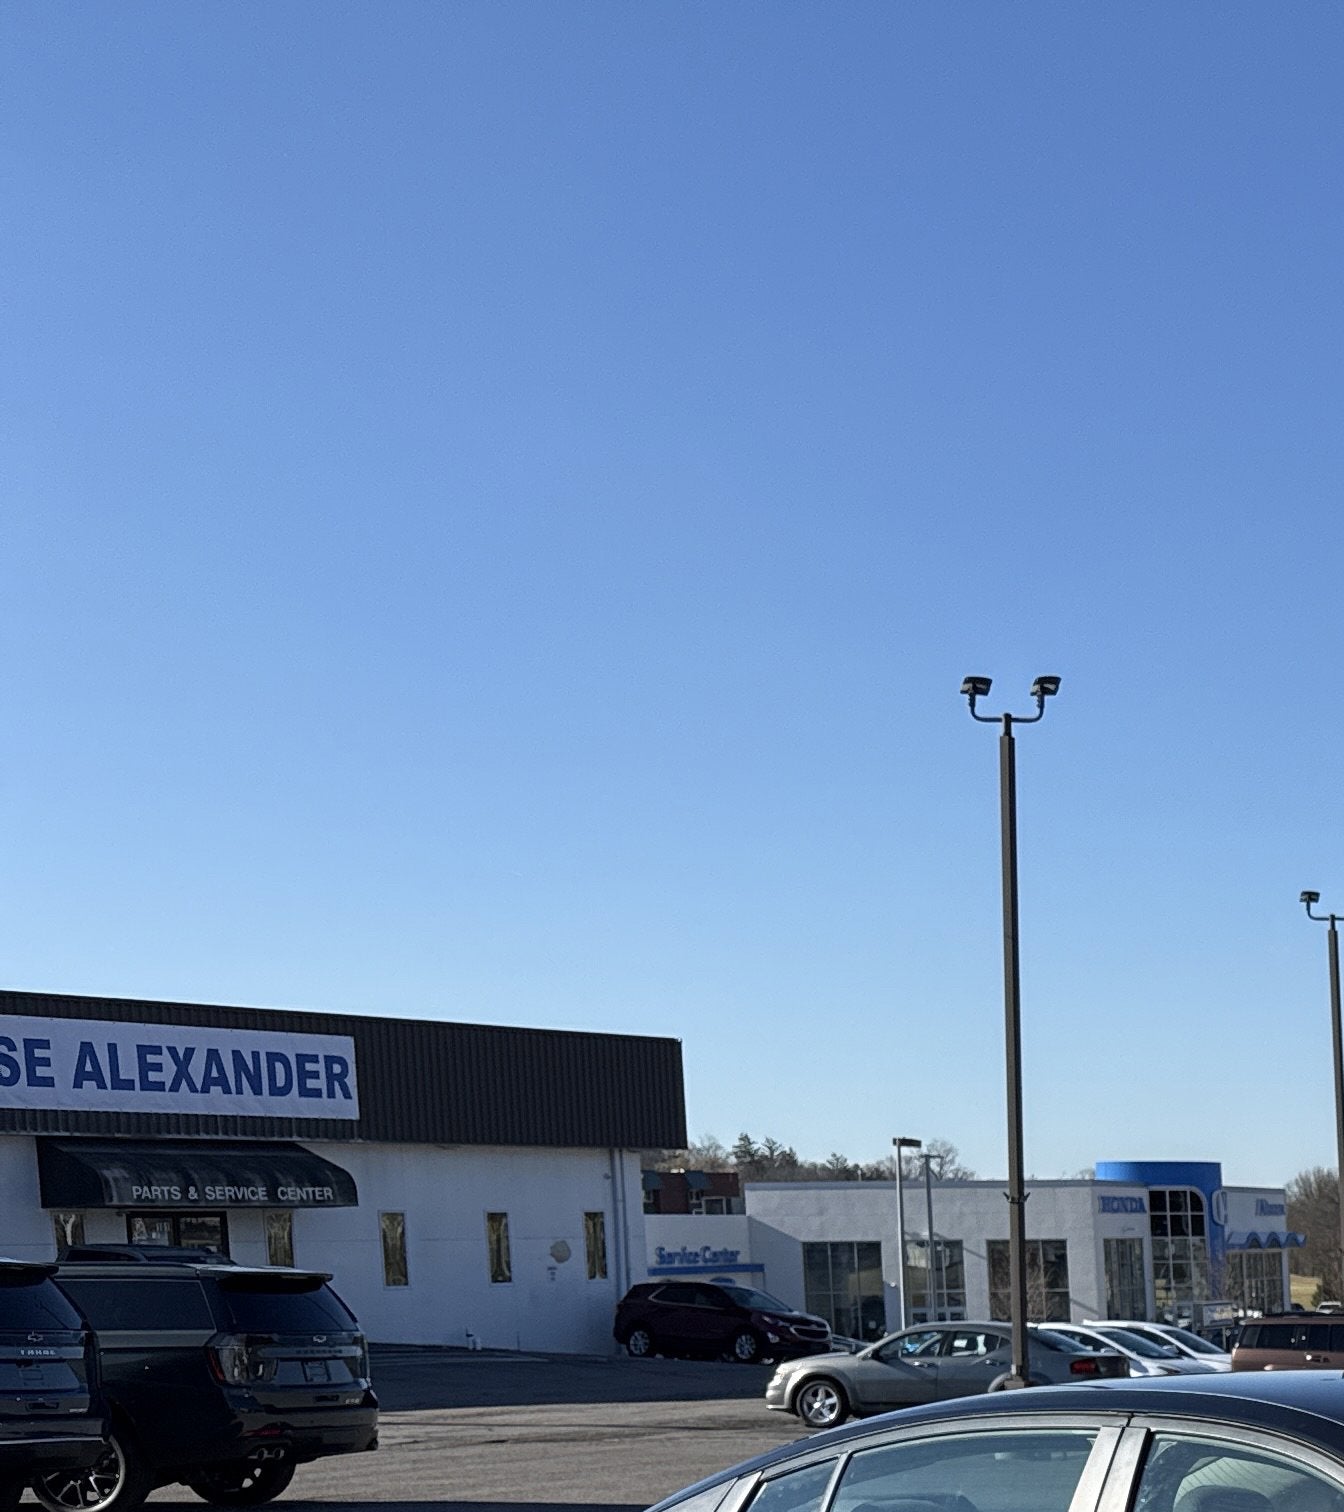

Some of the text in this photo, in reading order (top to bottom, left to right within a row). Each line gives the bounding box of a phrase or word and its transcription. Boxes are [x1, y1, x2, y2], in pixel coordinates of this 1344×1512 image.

[0, 1036, 353, 1100] SE ALEXANDER
[132, 1185, 333, 1200] PARTS & SERVICE CENTER
